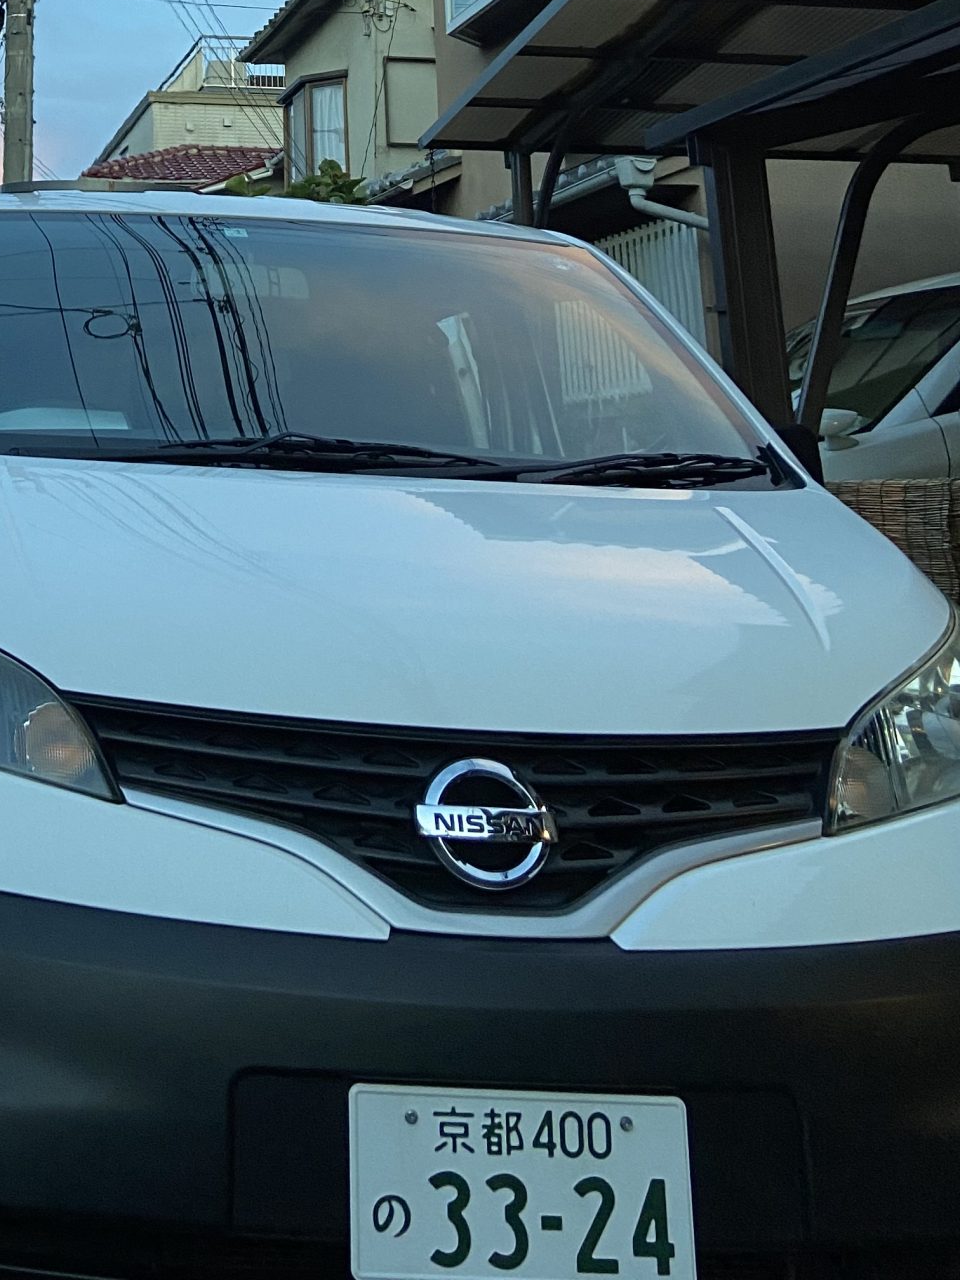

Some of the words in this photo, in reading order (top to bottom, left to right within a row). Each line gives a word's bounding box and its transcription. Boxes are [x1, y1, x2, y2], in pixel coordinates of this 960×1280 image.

[434, 812, 545, 837] NISSAN
[372, 1194, 412, 1238] の
[428, 1170, 675, 1276] 33-24
